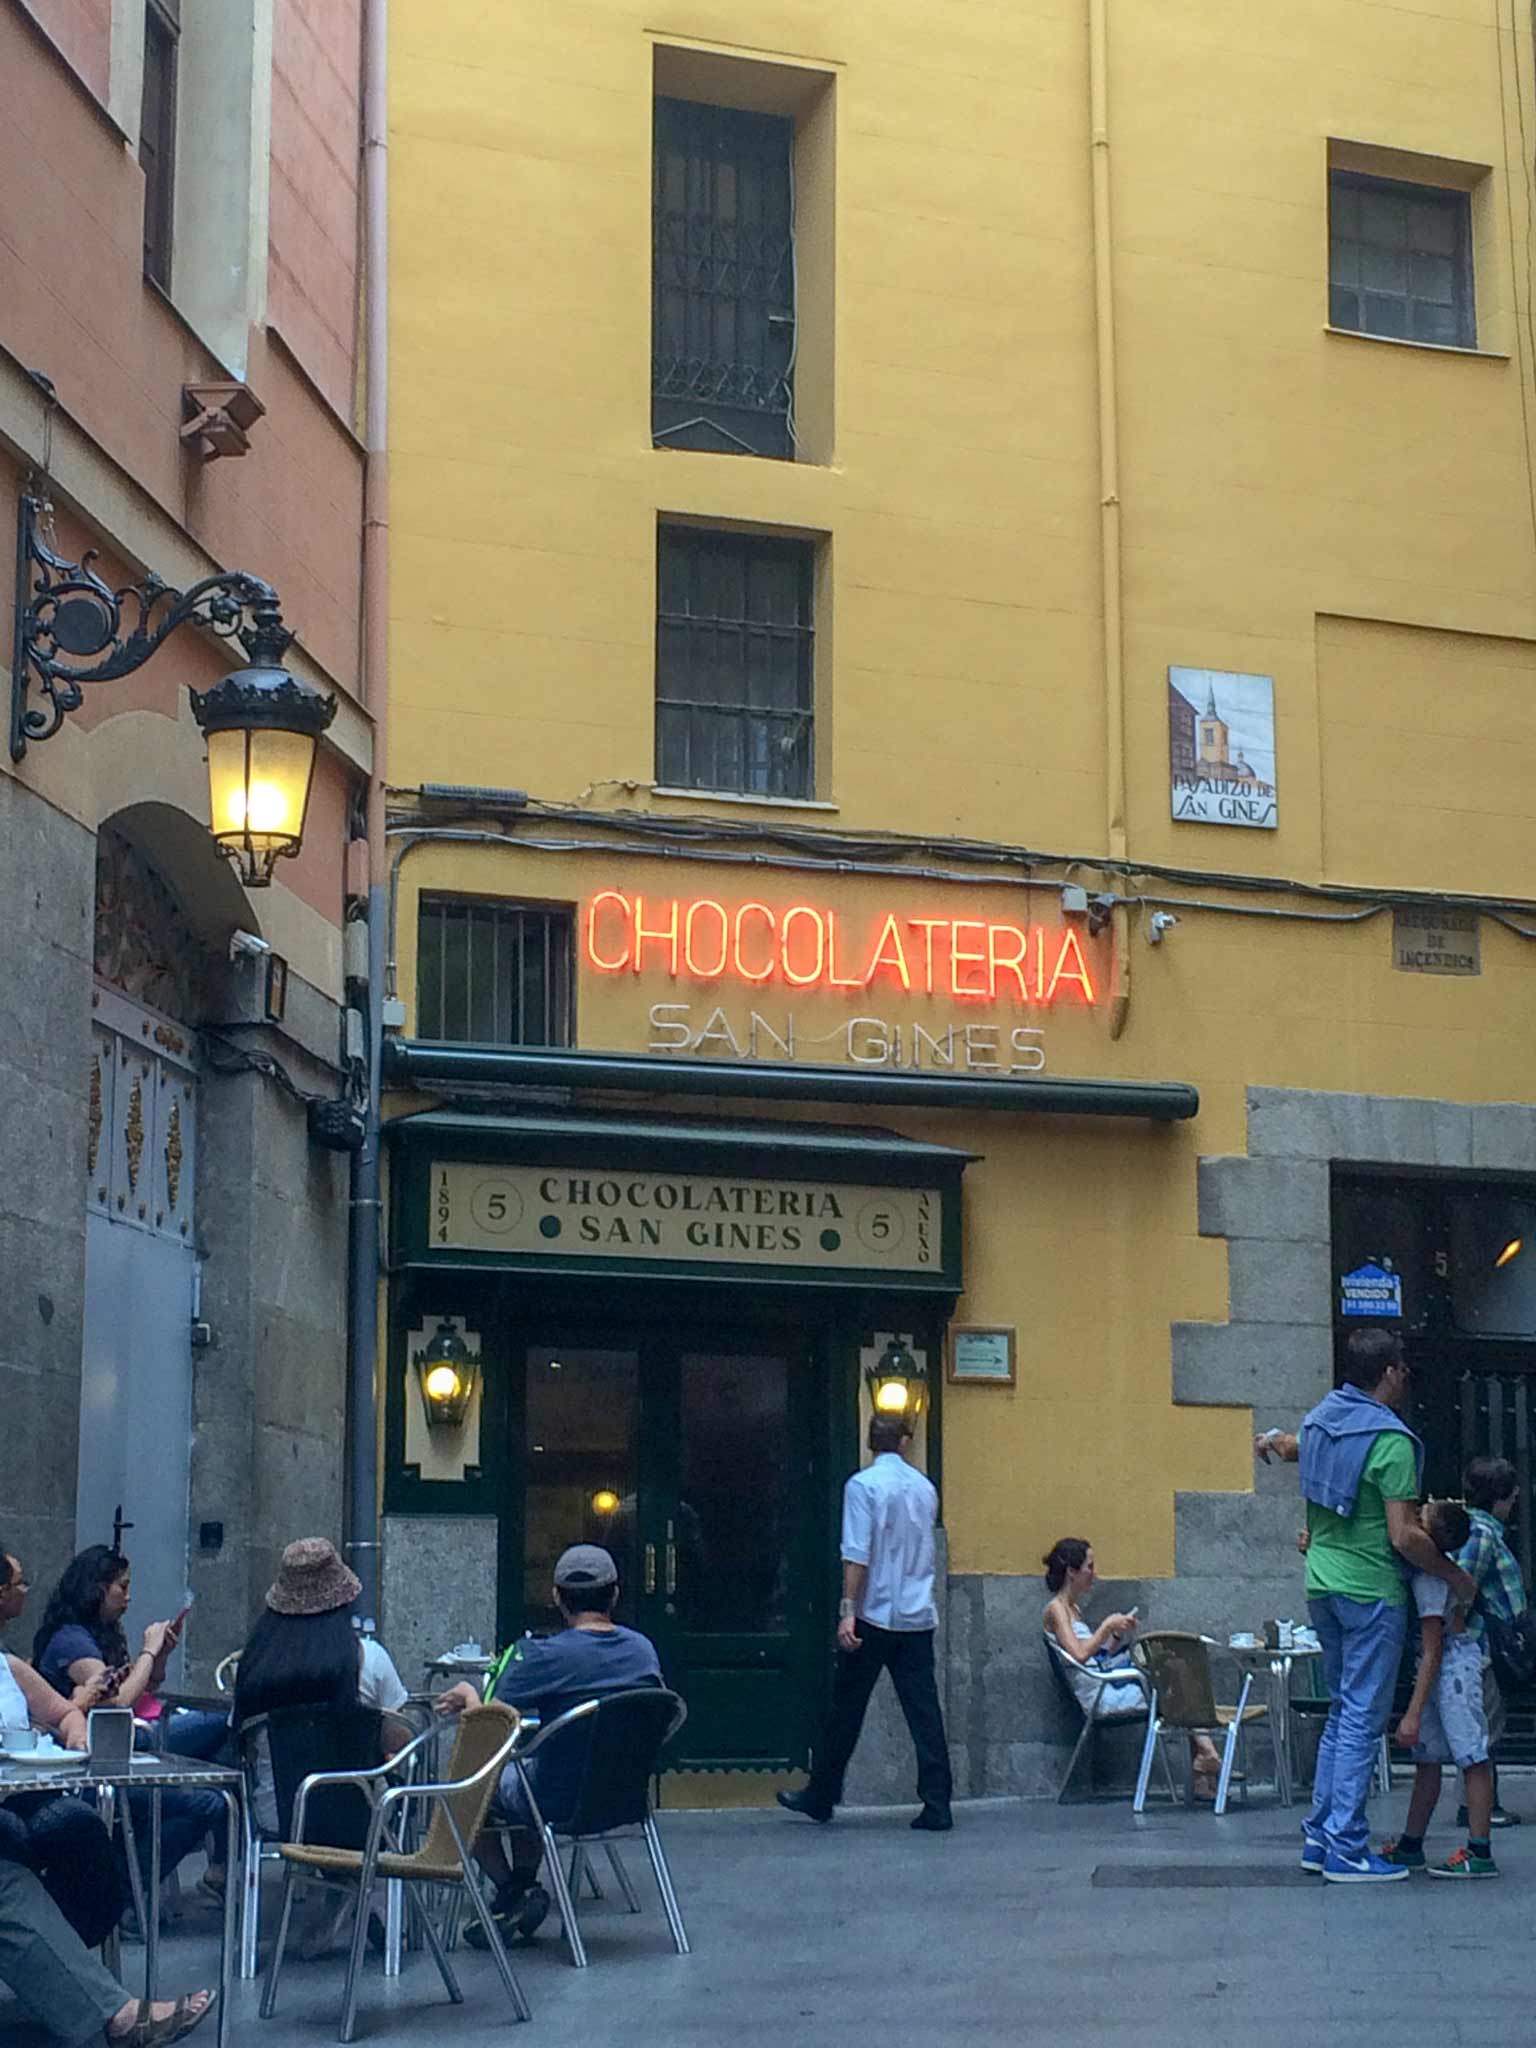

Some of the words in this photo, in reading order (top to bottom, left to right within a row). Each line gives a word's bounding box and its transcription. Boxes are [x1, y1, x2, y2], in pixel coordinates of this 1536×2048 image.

[1173, 774, 1252, 798] PASADIZO
[1257, 782, 1276, 798] DE
[1175, 794, 1208, 817] SAN
[1218, 797, 1277, 824] GINES
[587, 890, 1096, 1002] CHOCOLATERIA
[648, 1003, 795, 1058] SAN
[847, 1017, 1046, 1070] GINES
[438, 1169, 450, 1243] 1894
[486, 1193, 507, 1221] 5
[538, 1176, 843, 1219] CHOCOLATERIA
[578, 1214, 664, 1246] SAN
[685, 1220, 802, 1251] GINES
[871, 1213, 891, 1240] 5
[916, 1192, 931, 1264] ANEXO
[1435, 1251, 1448, 1277] 5
